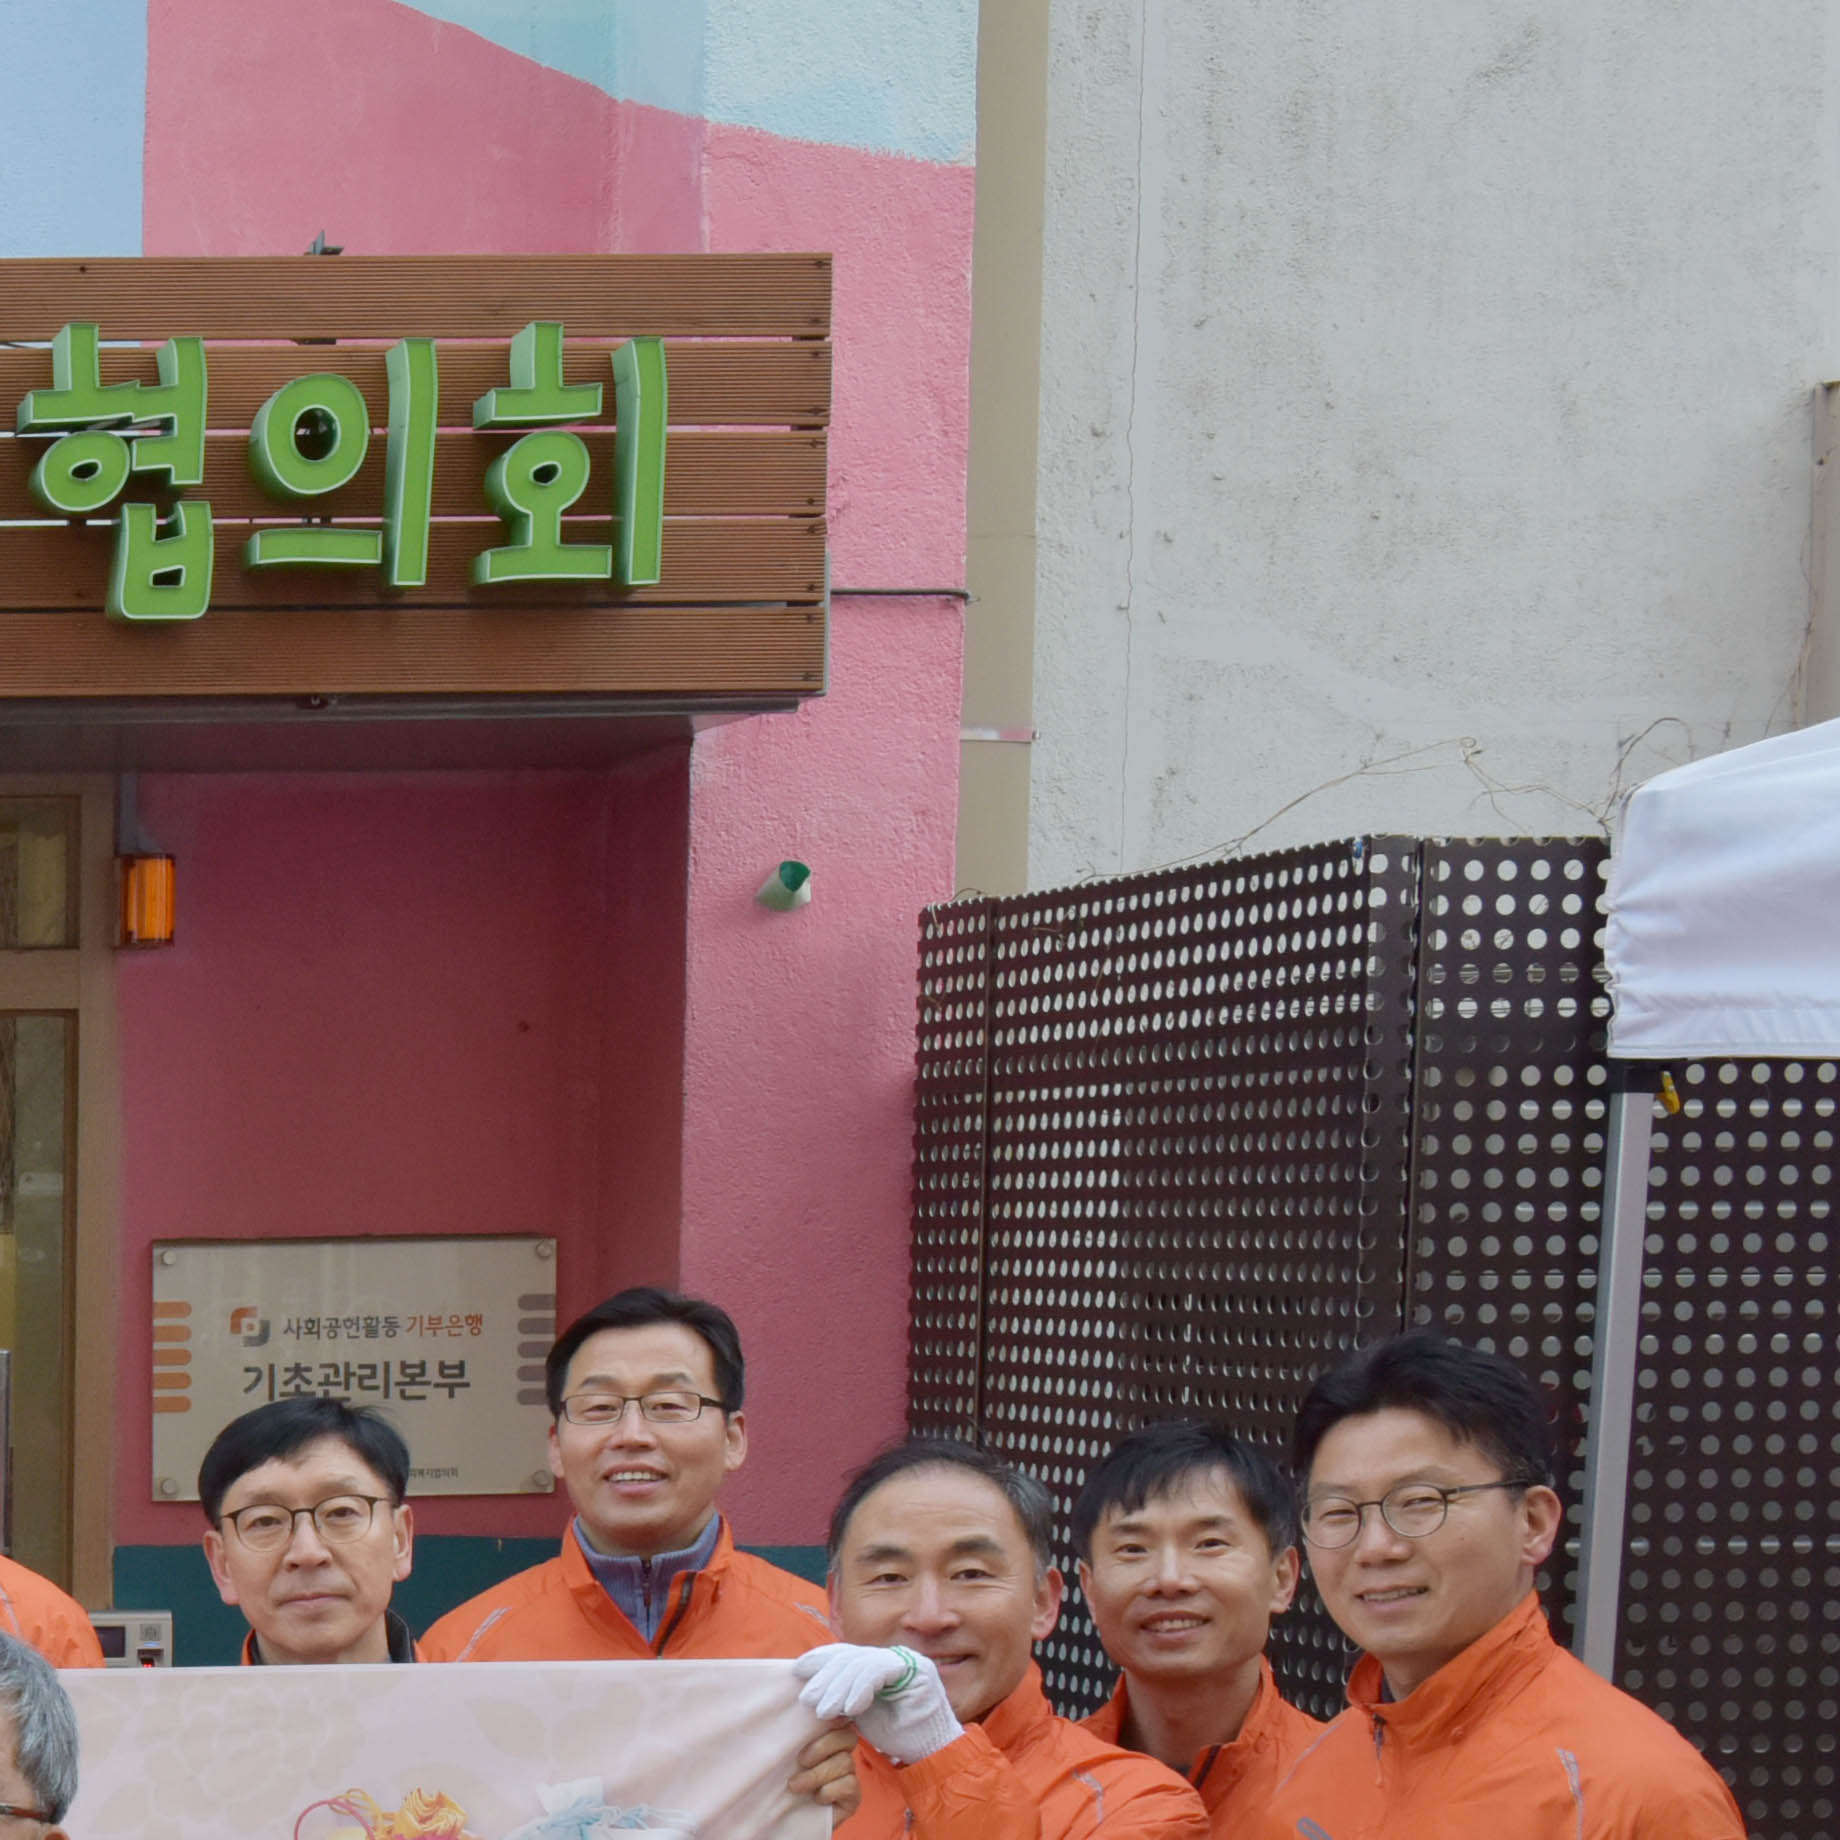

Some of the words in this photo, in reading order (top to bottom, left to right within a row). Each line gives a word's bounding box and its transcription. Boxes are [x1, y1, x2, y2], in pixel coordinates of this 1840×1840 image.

[283, 1315, 400, 1340] 사회공헌활동
[406, 1313, 484, 1338] 기부은행
[243, 1360, 471, 1401] 기초관리본부
